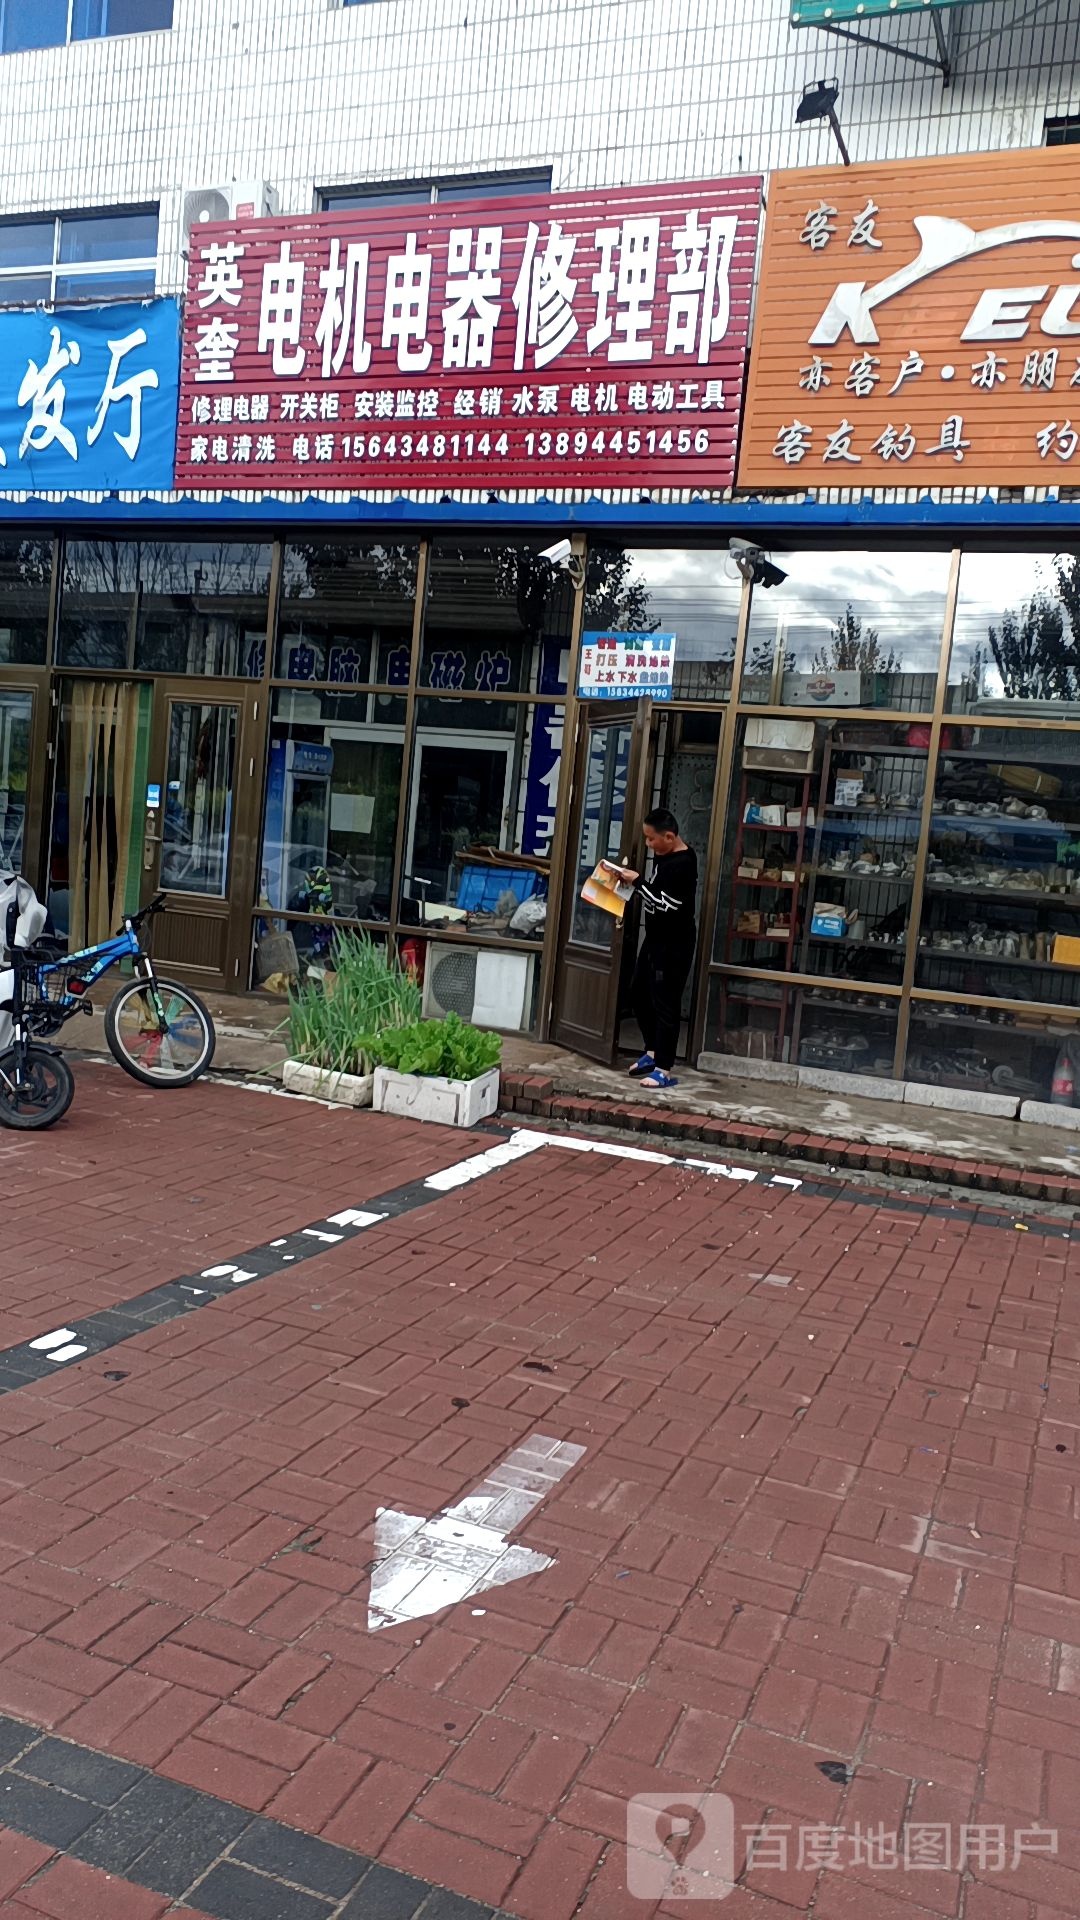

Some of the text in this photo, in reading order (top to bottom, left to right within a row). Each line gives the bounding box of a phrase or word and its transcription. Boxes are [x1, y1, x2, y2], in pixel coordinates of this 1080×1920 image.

[799, 199, 883, 250] 客友
[193, 241, 246, 382] 英奎
[257, 209, 739, 378] 电机电器修理部
[0, 325, 160, 466] 发厅
[799, 348, 1080, 396] 亦客户·亦朋
[191, 379, 726, 423] 修理电器 开关柜 安装监控 经销 水泵 电机 电动工具
[190, 428, 710, 462] 家电清洗 电话 15643481144 13894451456
[772, 414, 1079, 464] 客友钓具 约
[594, 670, 638, 683] 上水下水
